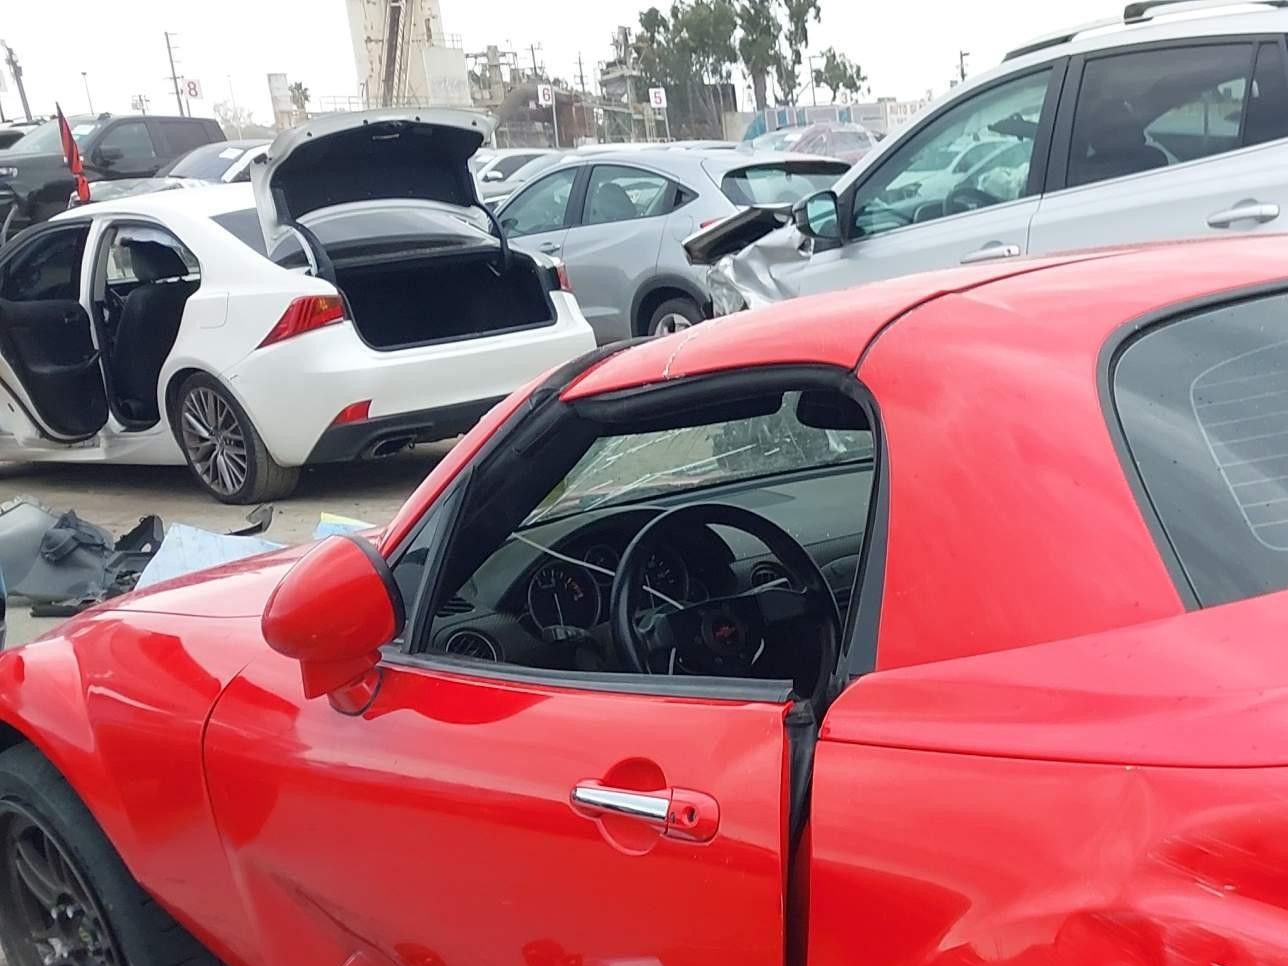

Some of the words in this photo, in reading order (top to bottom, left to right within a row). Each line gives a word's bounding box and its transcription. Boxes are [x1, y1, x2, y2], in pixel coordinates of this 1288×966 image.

[186, 80, 199, 97] 8
[542, 87, 551, 102] 6
[653, 90, 663, 105] 5
